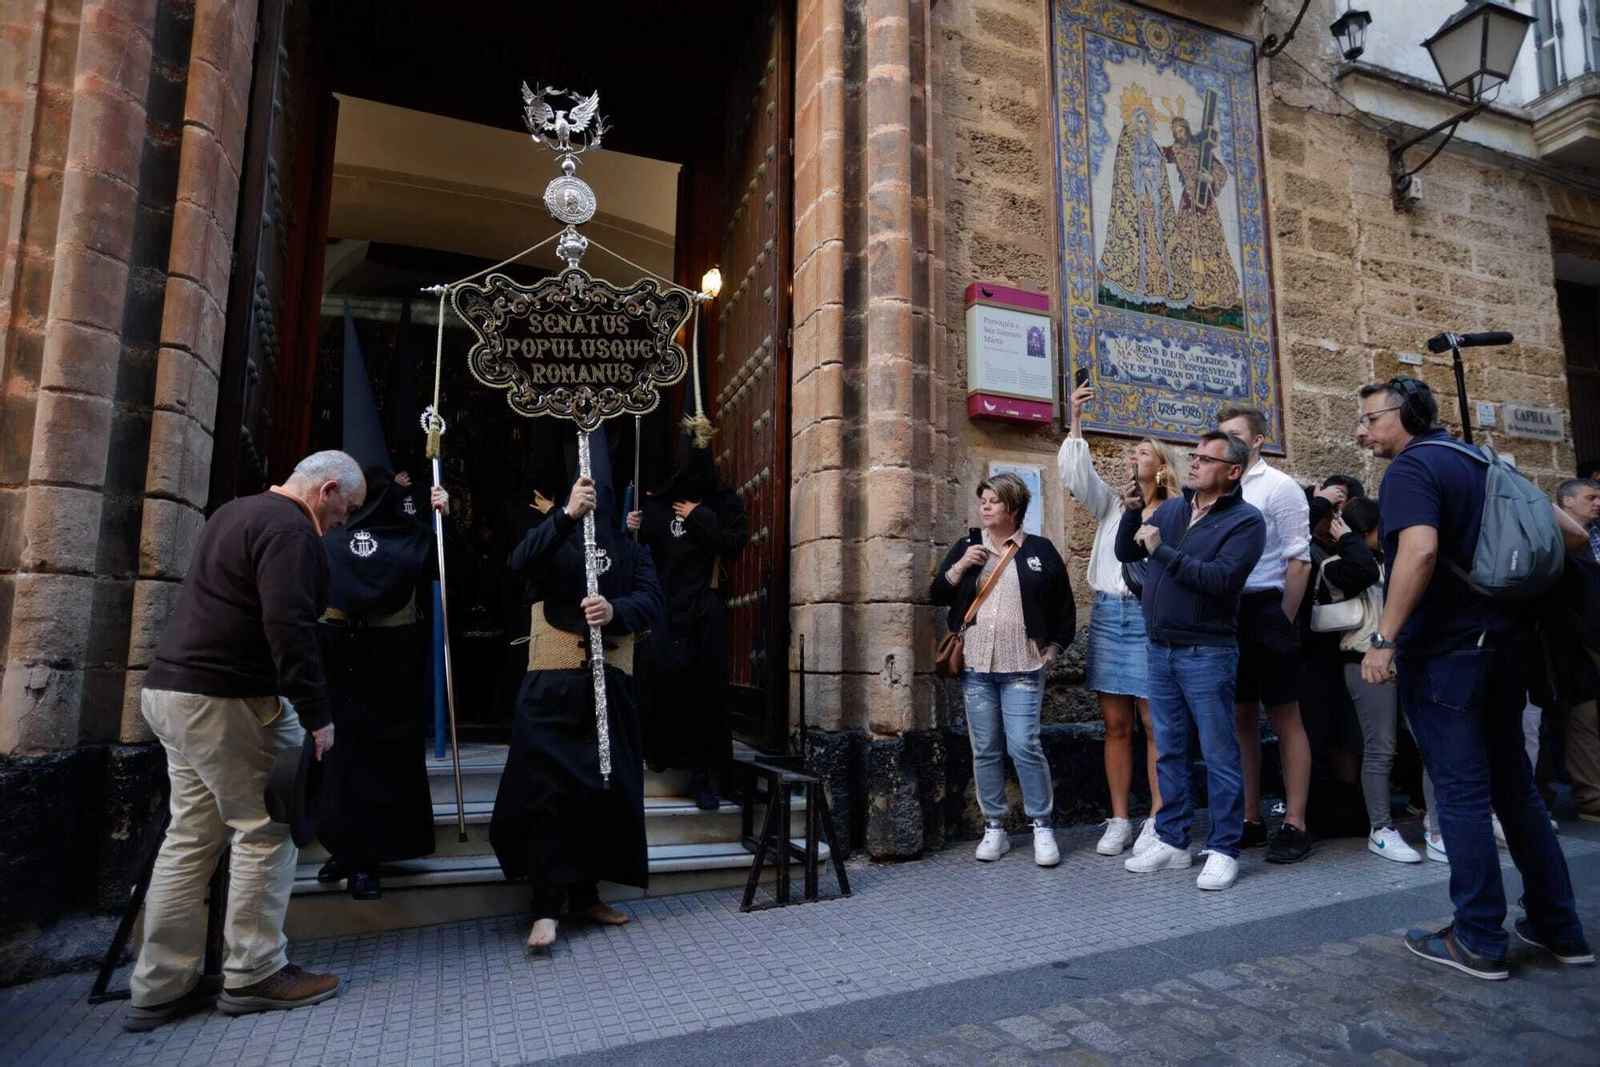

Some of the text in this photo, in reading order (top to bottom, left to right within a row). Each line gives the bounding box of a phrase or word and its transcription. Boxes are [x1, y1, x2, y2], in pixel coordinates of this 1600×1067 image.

[528, 313, 630, 335] SENATUS
[505, 337, 654, 360] POPULUSQUE
[1138, 364, 1148, 373] SE
[1170, 350, 1186, 360] LOS
[1231, 360, 1238, 369] Y
[531, 363, 635, 384] ROMANUS
[1157, 402, 1201, 419] 1726-1926
[1514, 408, 1553, 426] CAPILLA
